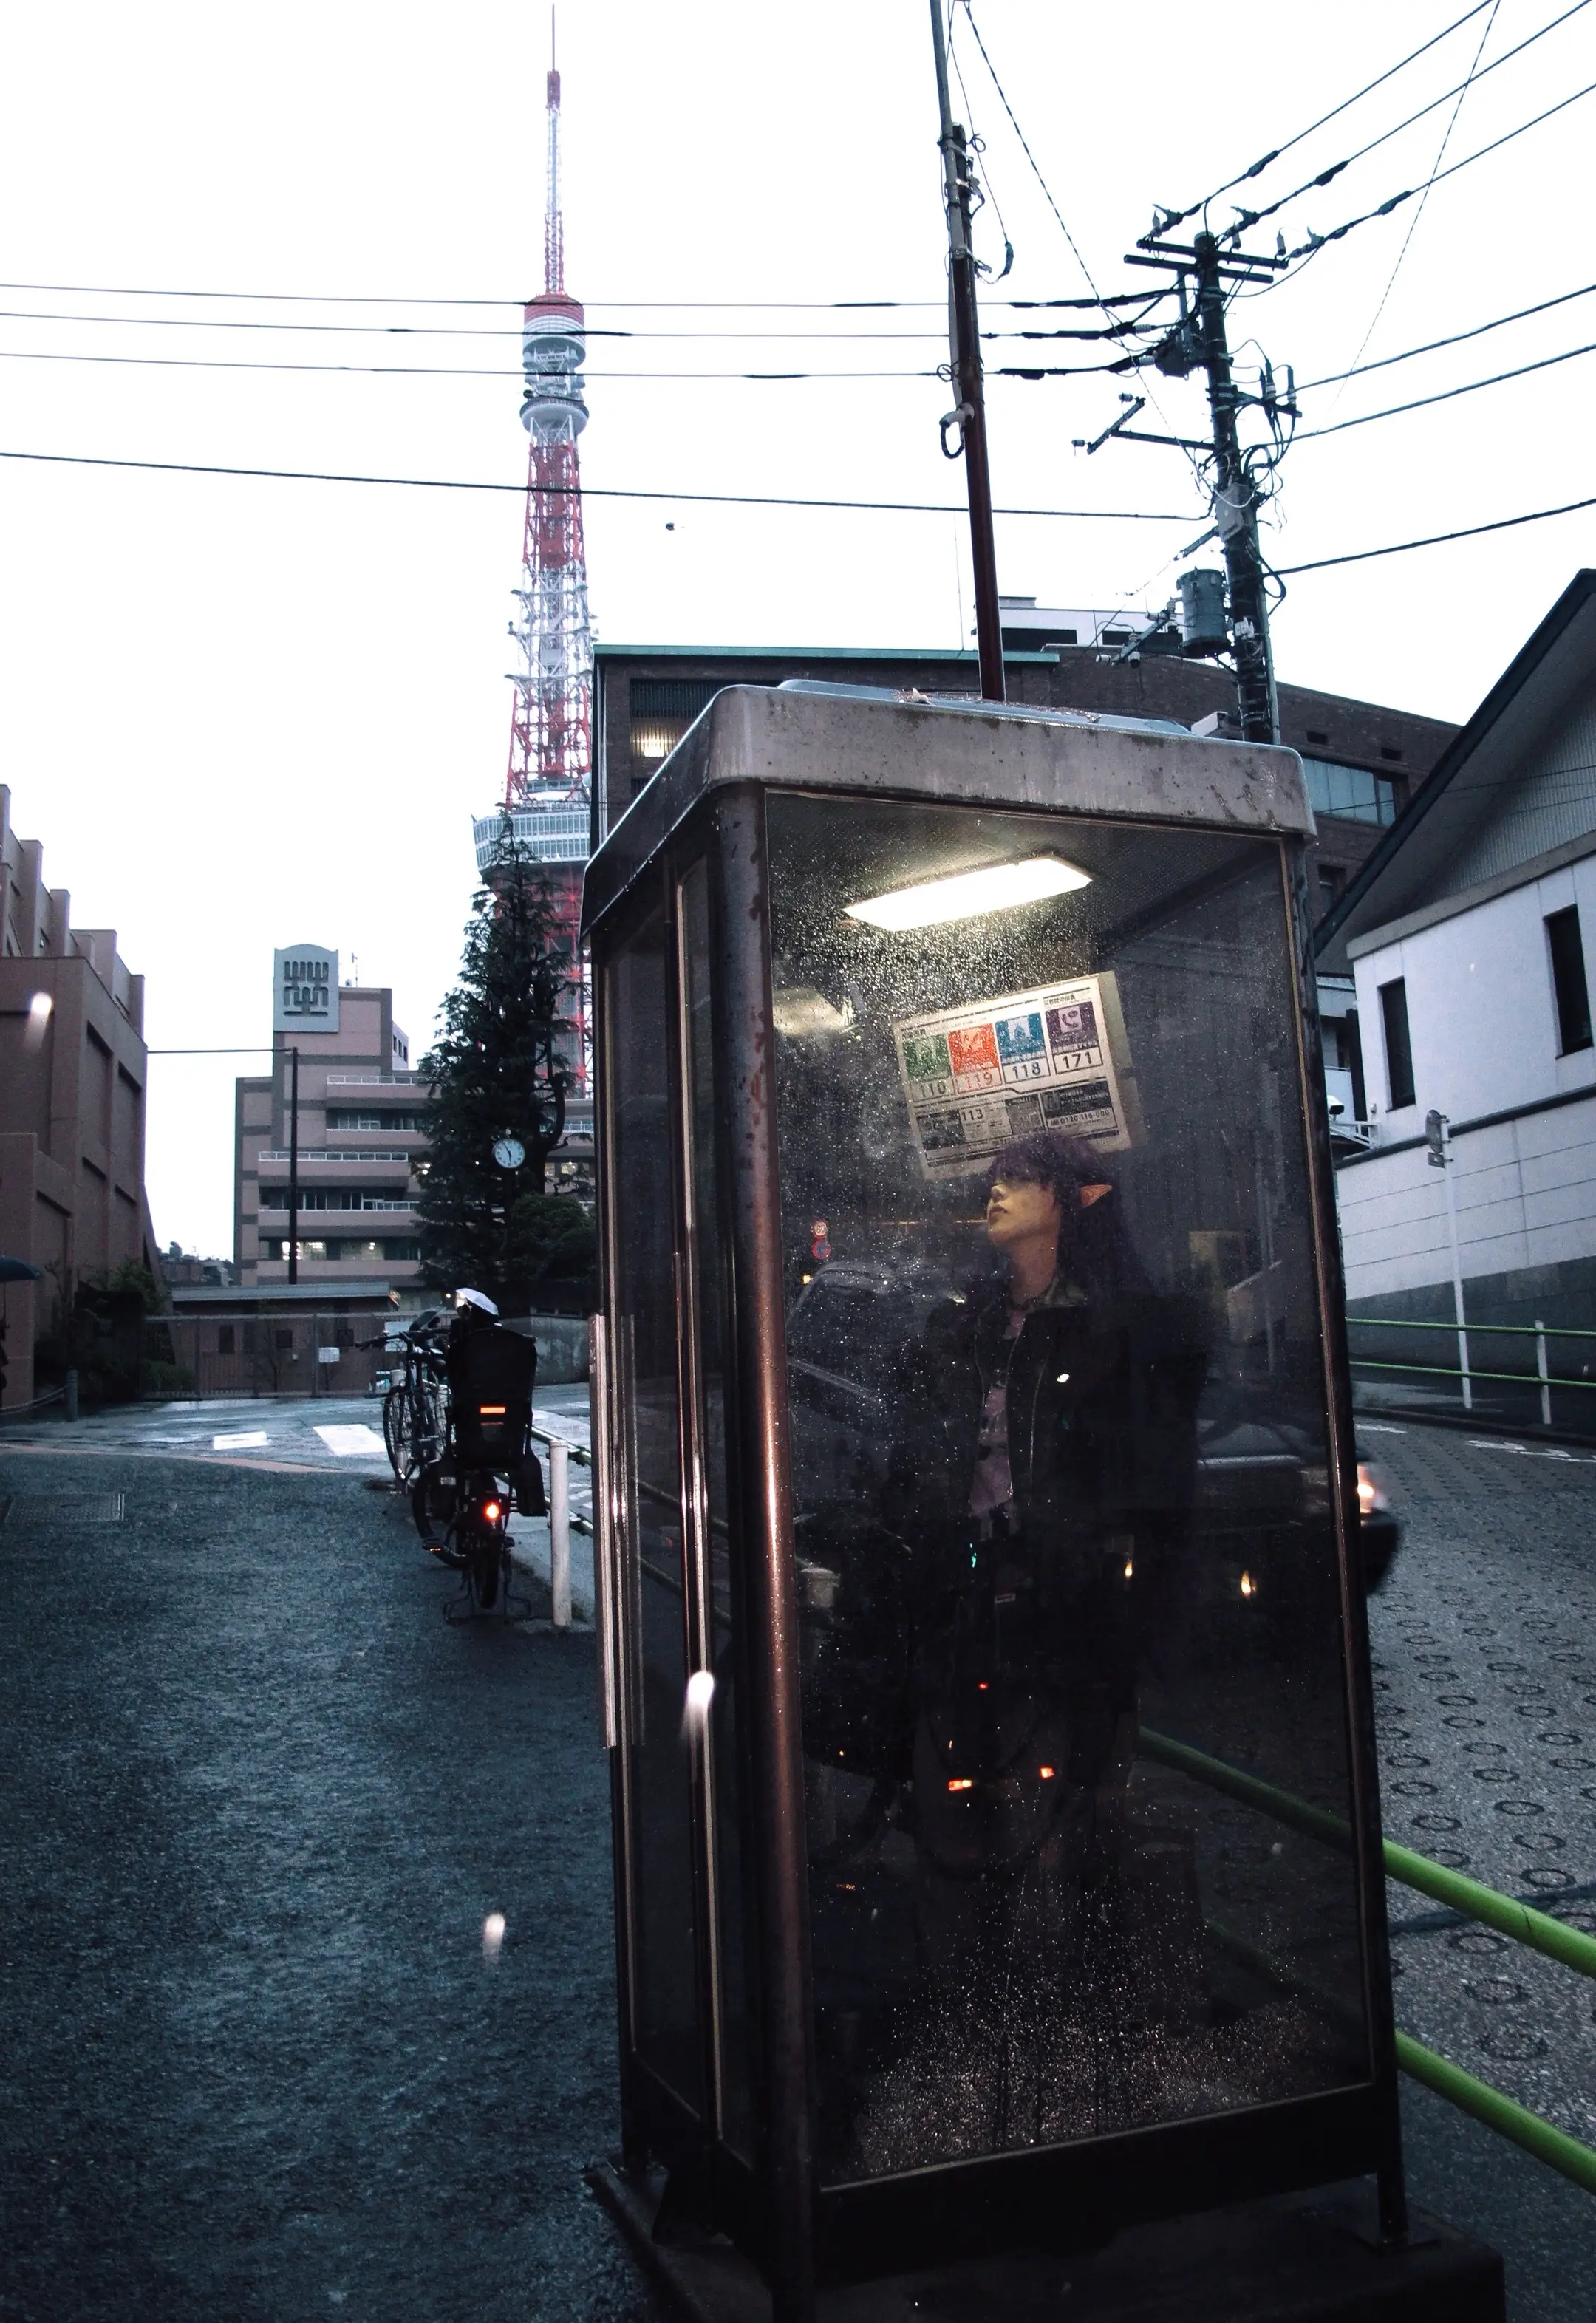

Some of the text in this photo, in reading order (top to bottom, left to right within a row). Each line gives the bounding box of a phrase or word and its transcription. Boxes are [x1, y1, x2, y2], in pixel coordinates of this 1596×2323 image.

[1063, 1051, 1092, 1069] 171
[1012, 1062, 1041, 1079] 118
[965, 1071, 992, 1088] 119
[919, 1081, 947, 1098] 110
[962, 1108, 984, 1122] 113
